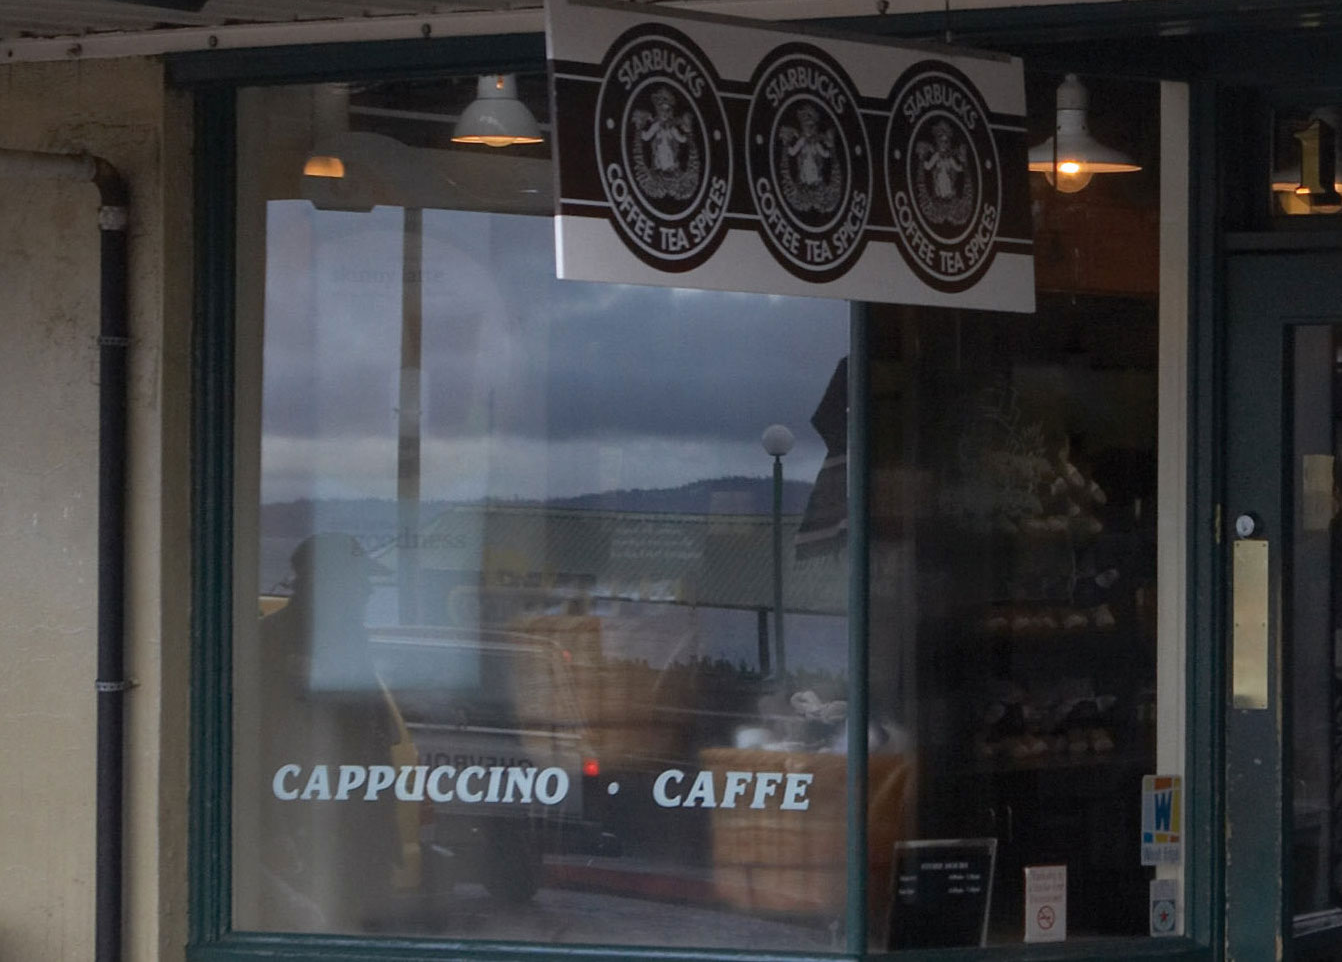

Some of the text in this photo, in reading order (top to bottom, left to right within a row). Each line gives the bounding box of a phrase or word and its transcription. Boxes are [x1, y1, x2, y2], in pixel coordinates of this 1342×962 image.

[618, 48, 705, 98] STARBUCKS
[766, 66, 846, 114] STARBUCKS
[903, 83, 978, 130] STARBUCKS
[607, 163, 727, 251] COFFEE TEA SPICES
[757, 177, 866, 263] COFFEE TEA SPICES
[895, 191, 996, 274] COFFEE TEA SPICES
[272, 764, 816, 811] CAPPUCCINO CAFFE
